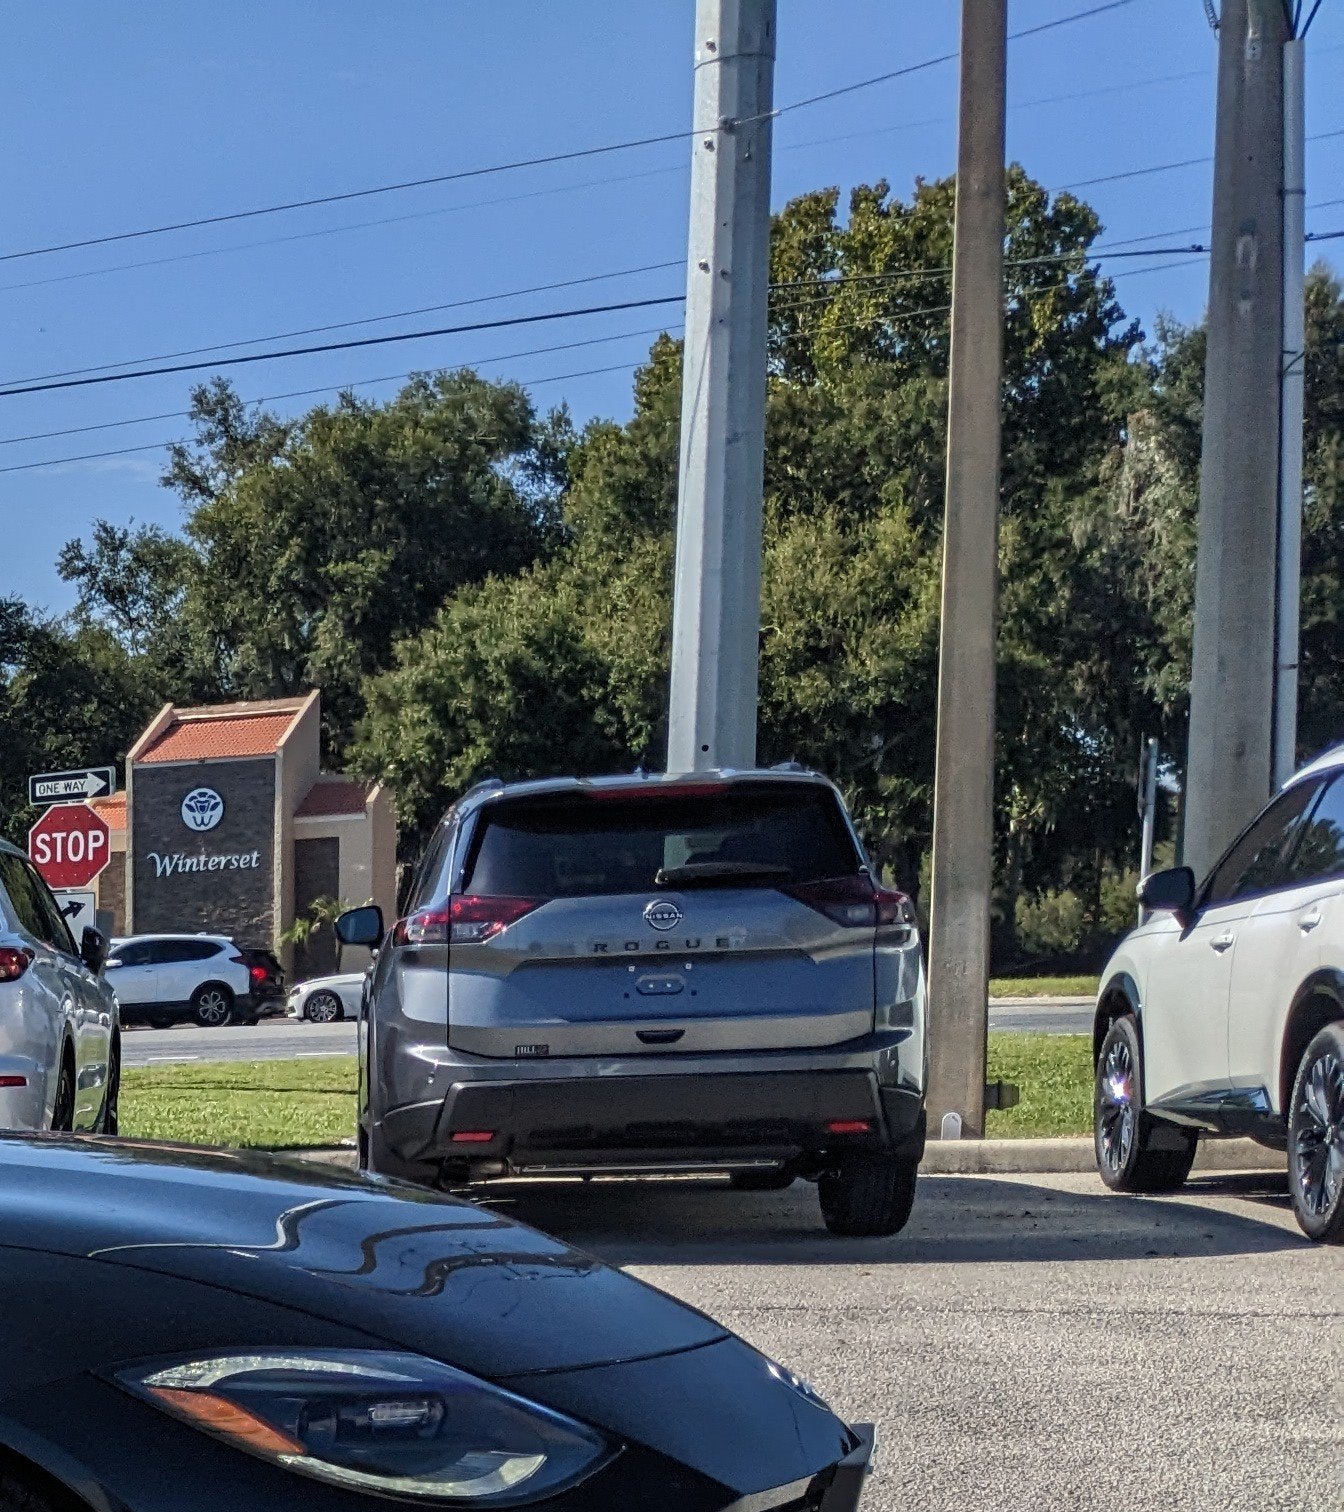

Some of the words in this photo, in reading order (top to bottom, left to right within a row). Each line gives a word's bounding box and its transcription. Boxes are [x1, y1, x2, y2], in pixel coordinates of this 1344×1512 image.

[38, 782, 60, 795] ONE
[64, 780, 86, 792] WAY
[34, 830, 105, 864] STOP
[146, 848, 261, 878] Winterset
[645, 912, 684, 921] NISSAN
[593, 938, 730, 953] ROGUE
